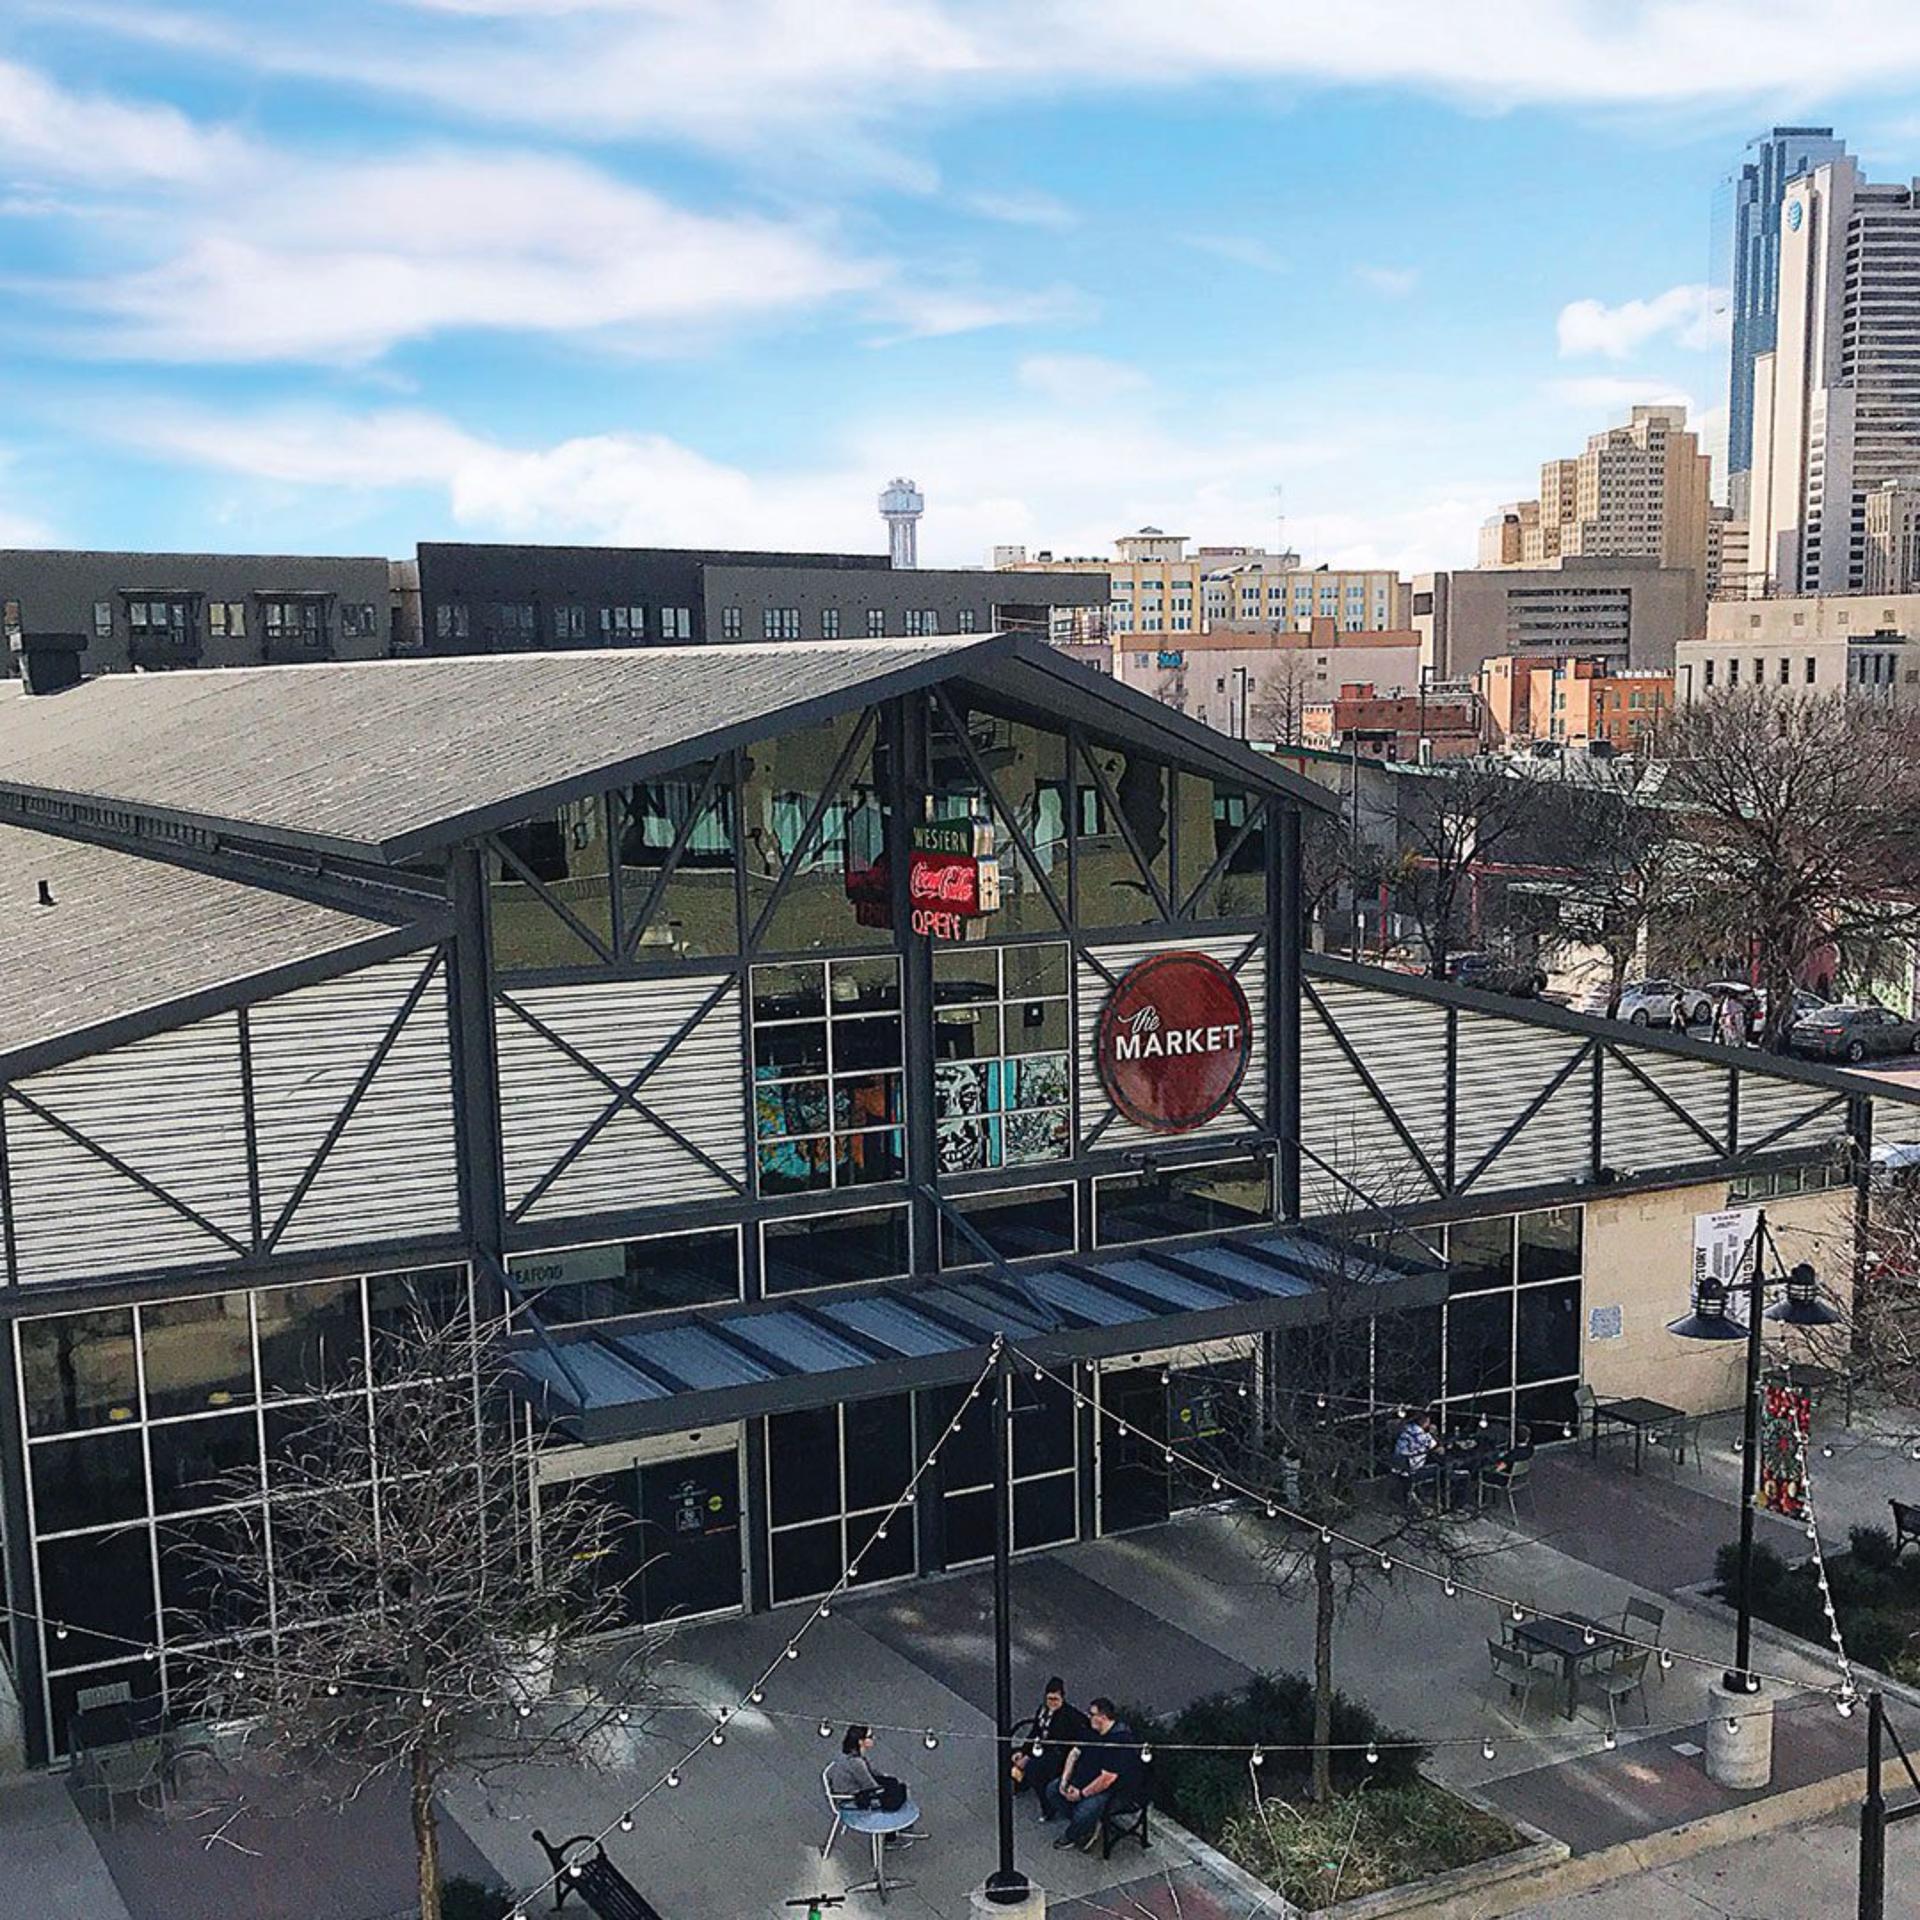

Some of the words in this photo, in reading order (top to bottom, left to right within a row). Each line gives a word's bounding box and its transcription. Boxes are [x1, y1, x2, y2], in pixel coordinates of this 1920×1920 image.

[914, 827, 968, 853] WESTERN
[912, 910, 960, 941] OPEN
[1117, 1005, 1160, 1034] The
[1116, 1025, 1239, 1061] MARKET
[513, 1264, 563, 1284] EAFOOD
